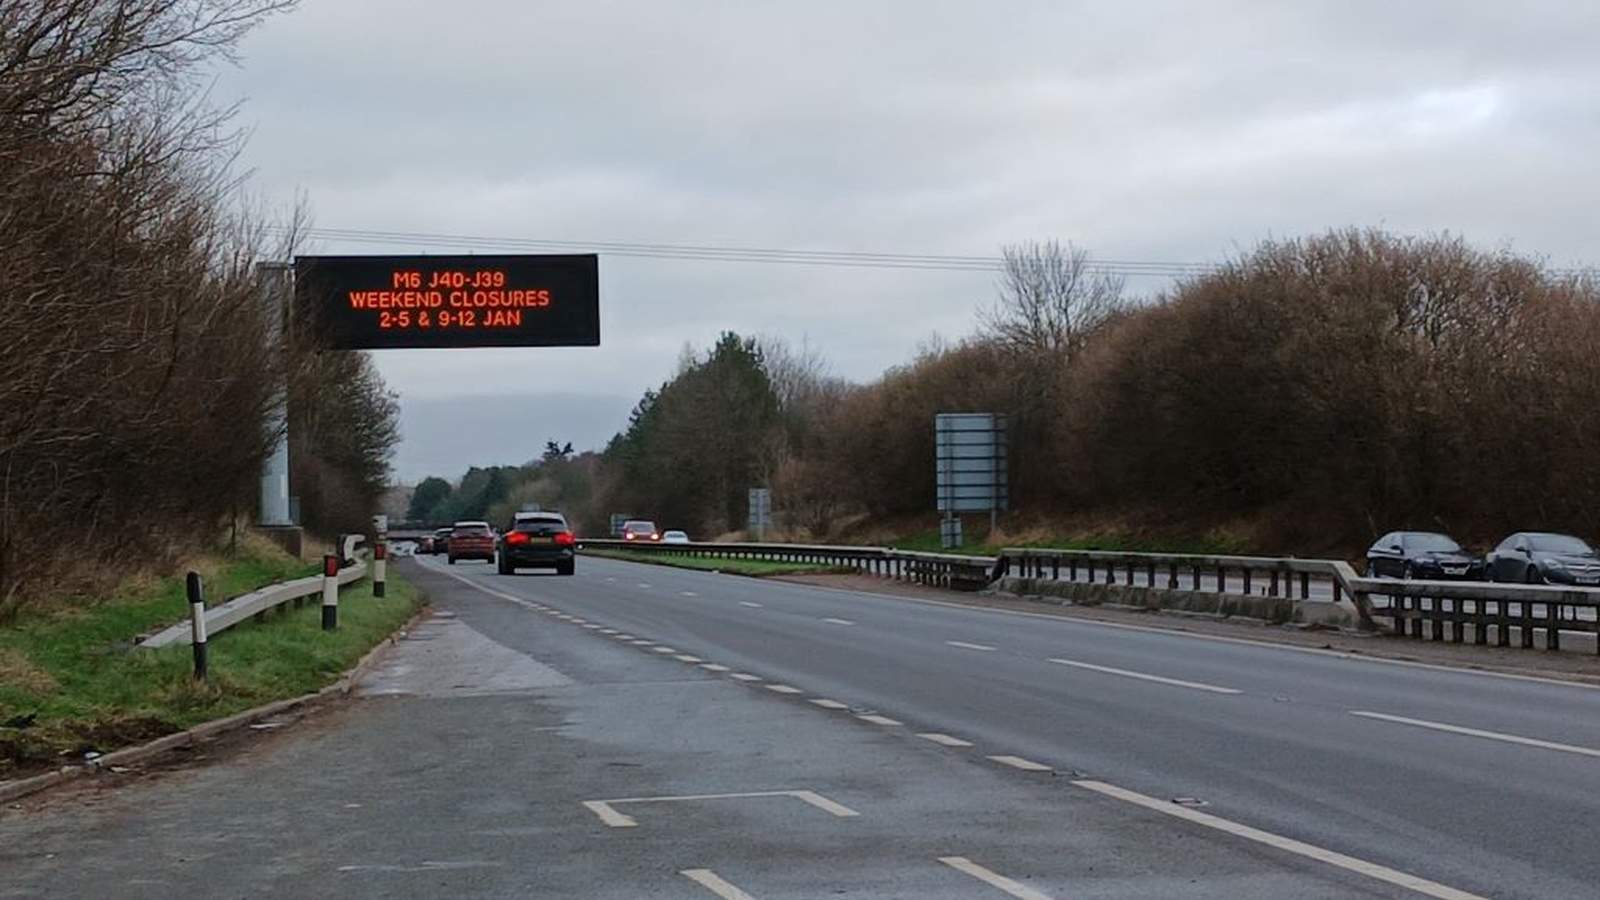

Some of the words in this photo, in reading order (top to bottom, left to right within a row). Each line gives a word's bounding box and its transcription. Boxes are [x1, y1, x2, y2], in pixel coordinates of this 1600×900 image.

[393, 272, 421, 289] M6
[428, 272, 505, 288] J40-J39
[349, 291, 443, 308] WEEKEND
[449, 290, 550, 308] CLOSURES
[380, 311, 411, 328] 2-5
[418, 311, 430, 327] &
[438, 311, 476, 327] 9-12
[482, 310, 522, 327] JAN
